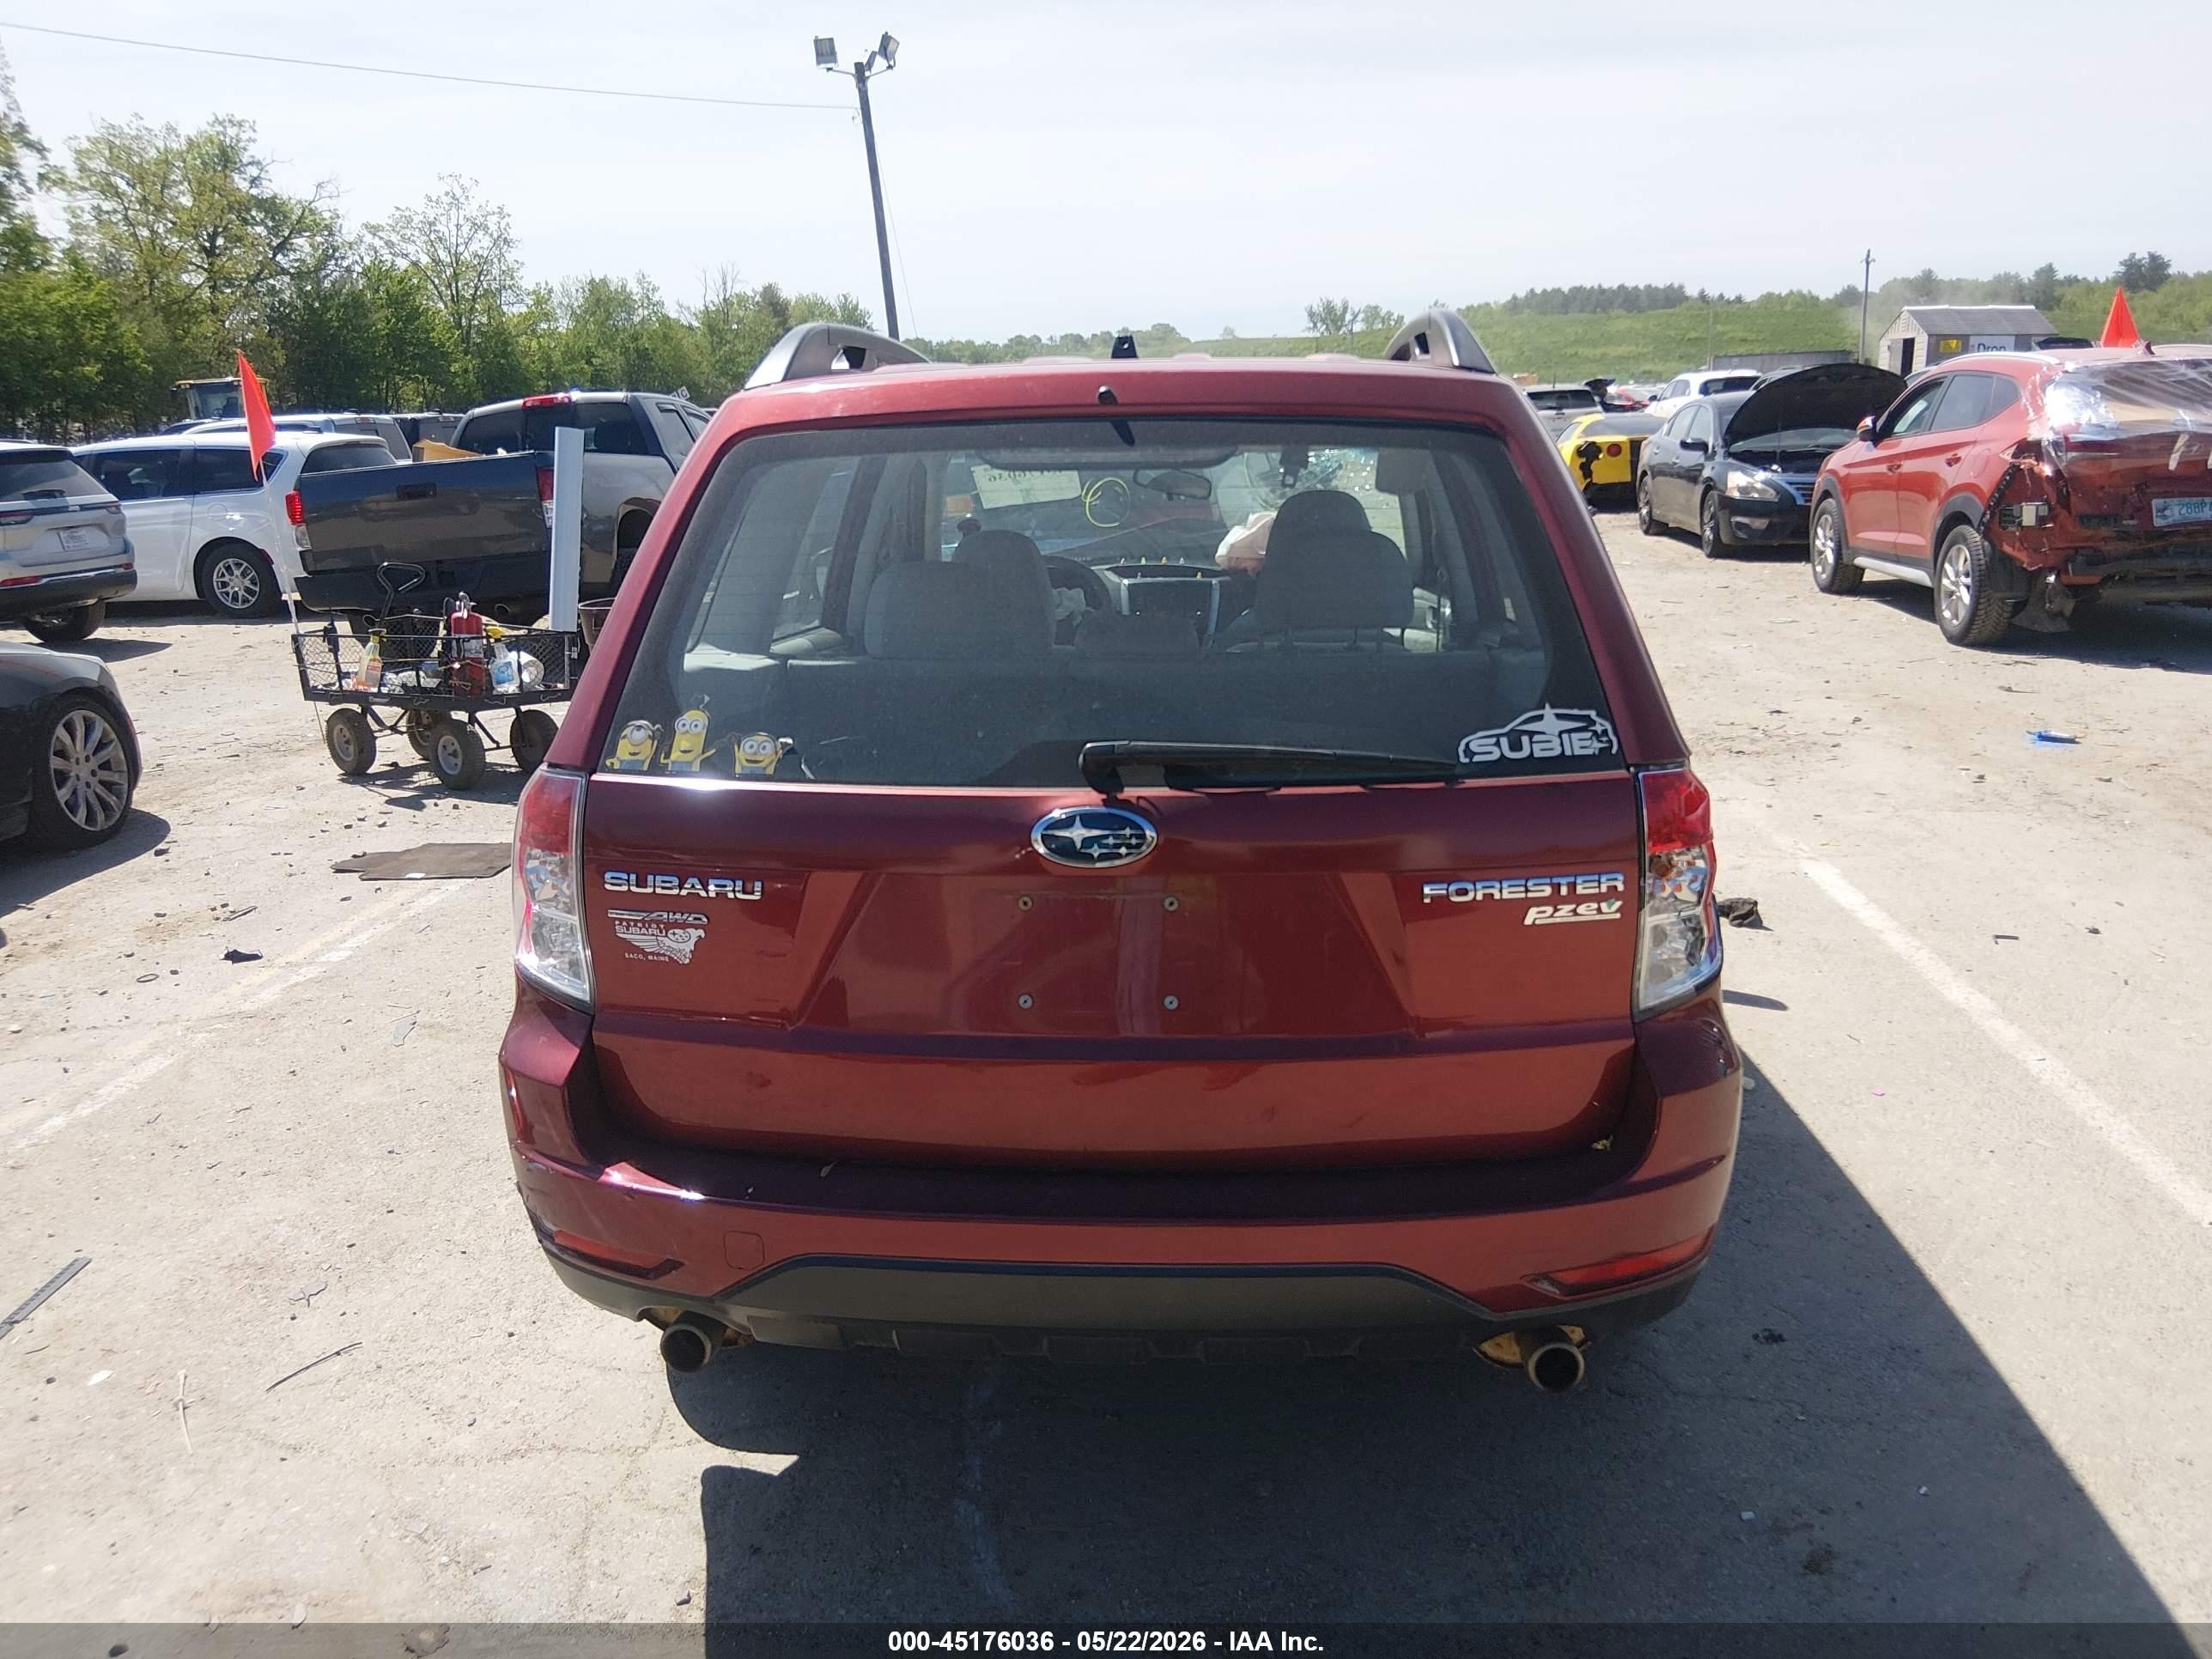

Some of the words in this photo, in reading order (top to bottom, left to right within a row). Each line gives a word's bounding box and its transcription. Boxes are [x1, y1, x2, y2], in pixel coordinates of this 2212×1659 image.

[1469, 732, 1596, 762] SUBIE
[604, 871, 763, 901] SUBARU
[1422, 872, 1625, 903] FORESTER
[615, 921, 665, 930] PATRIOT
[644, 911, 708, 925] AWD
[616, 926, 666, 936] SUBARU
